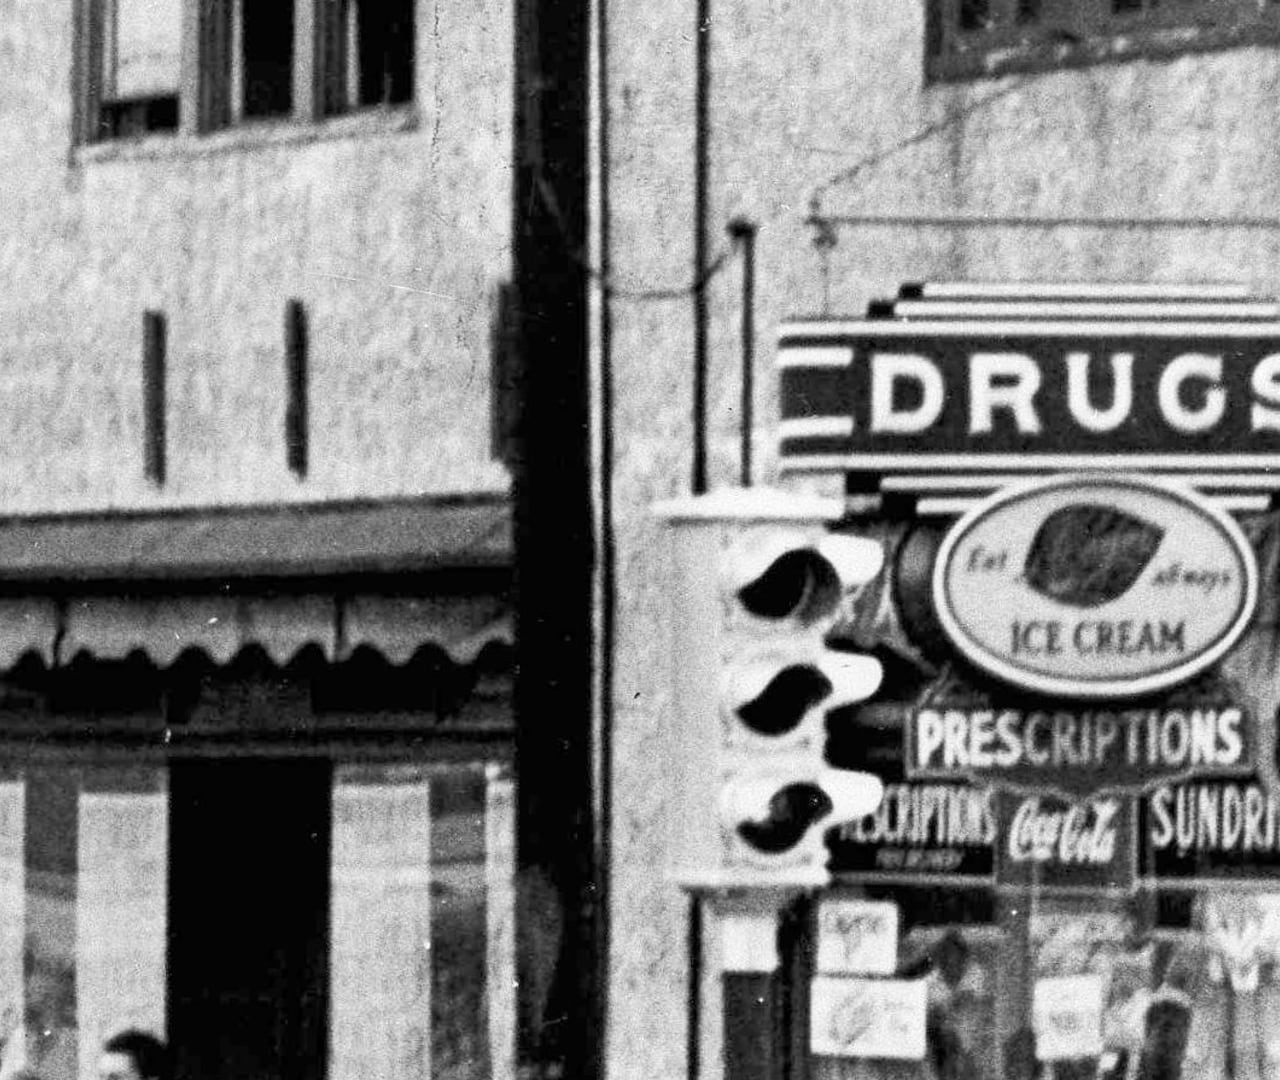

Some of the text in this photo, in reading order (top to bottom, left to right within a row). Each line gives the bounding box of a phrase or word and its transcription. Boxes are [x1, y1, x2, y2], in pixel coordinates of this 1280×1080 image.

[965, 543, 1008, 573] Eat
[1011, 620, 1186, 656] ICE CREAM
[918, 707, 1243, 768] PRESCRIPTIONS
